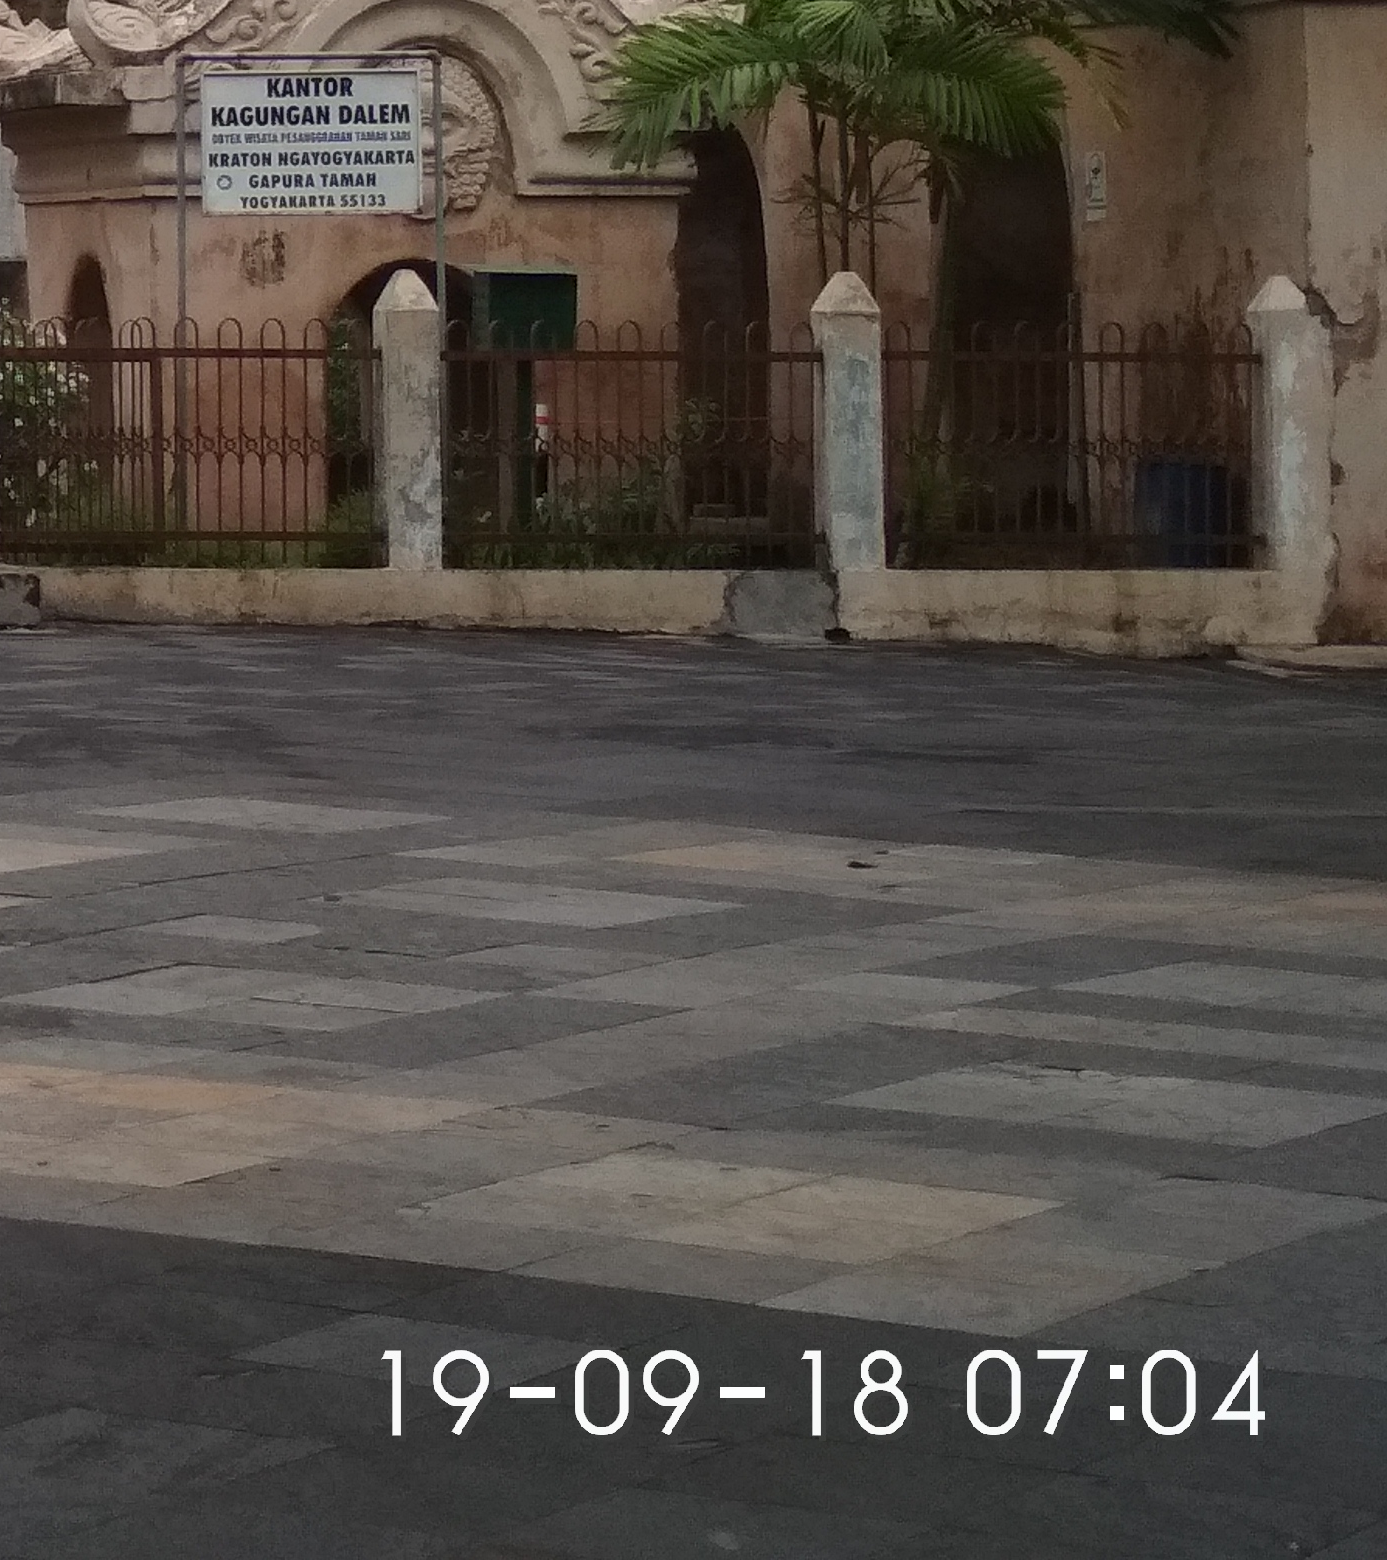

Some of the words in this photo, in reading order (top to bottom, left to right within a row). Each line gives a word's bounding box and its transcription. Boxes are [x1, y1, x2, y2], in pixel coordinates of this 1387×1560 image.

[267, 77, 354, 98] KANTOR
[211, 105, 330, 127] KAGUNGAN
[338, 104, 410, 125] DALEM
[208, 151, 272, 168] KRATON
[278, 150, 415, 167] NGAYOGYAKARTA
[249, 174, 314, 190] GAPURA
[321, 172, 376, 188] TAMAN
[240, 195, 335, 210] YOGYAKARTA
[340, 193, 386, 209] 55133
